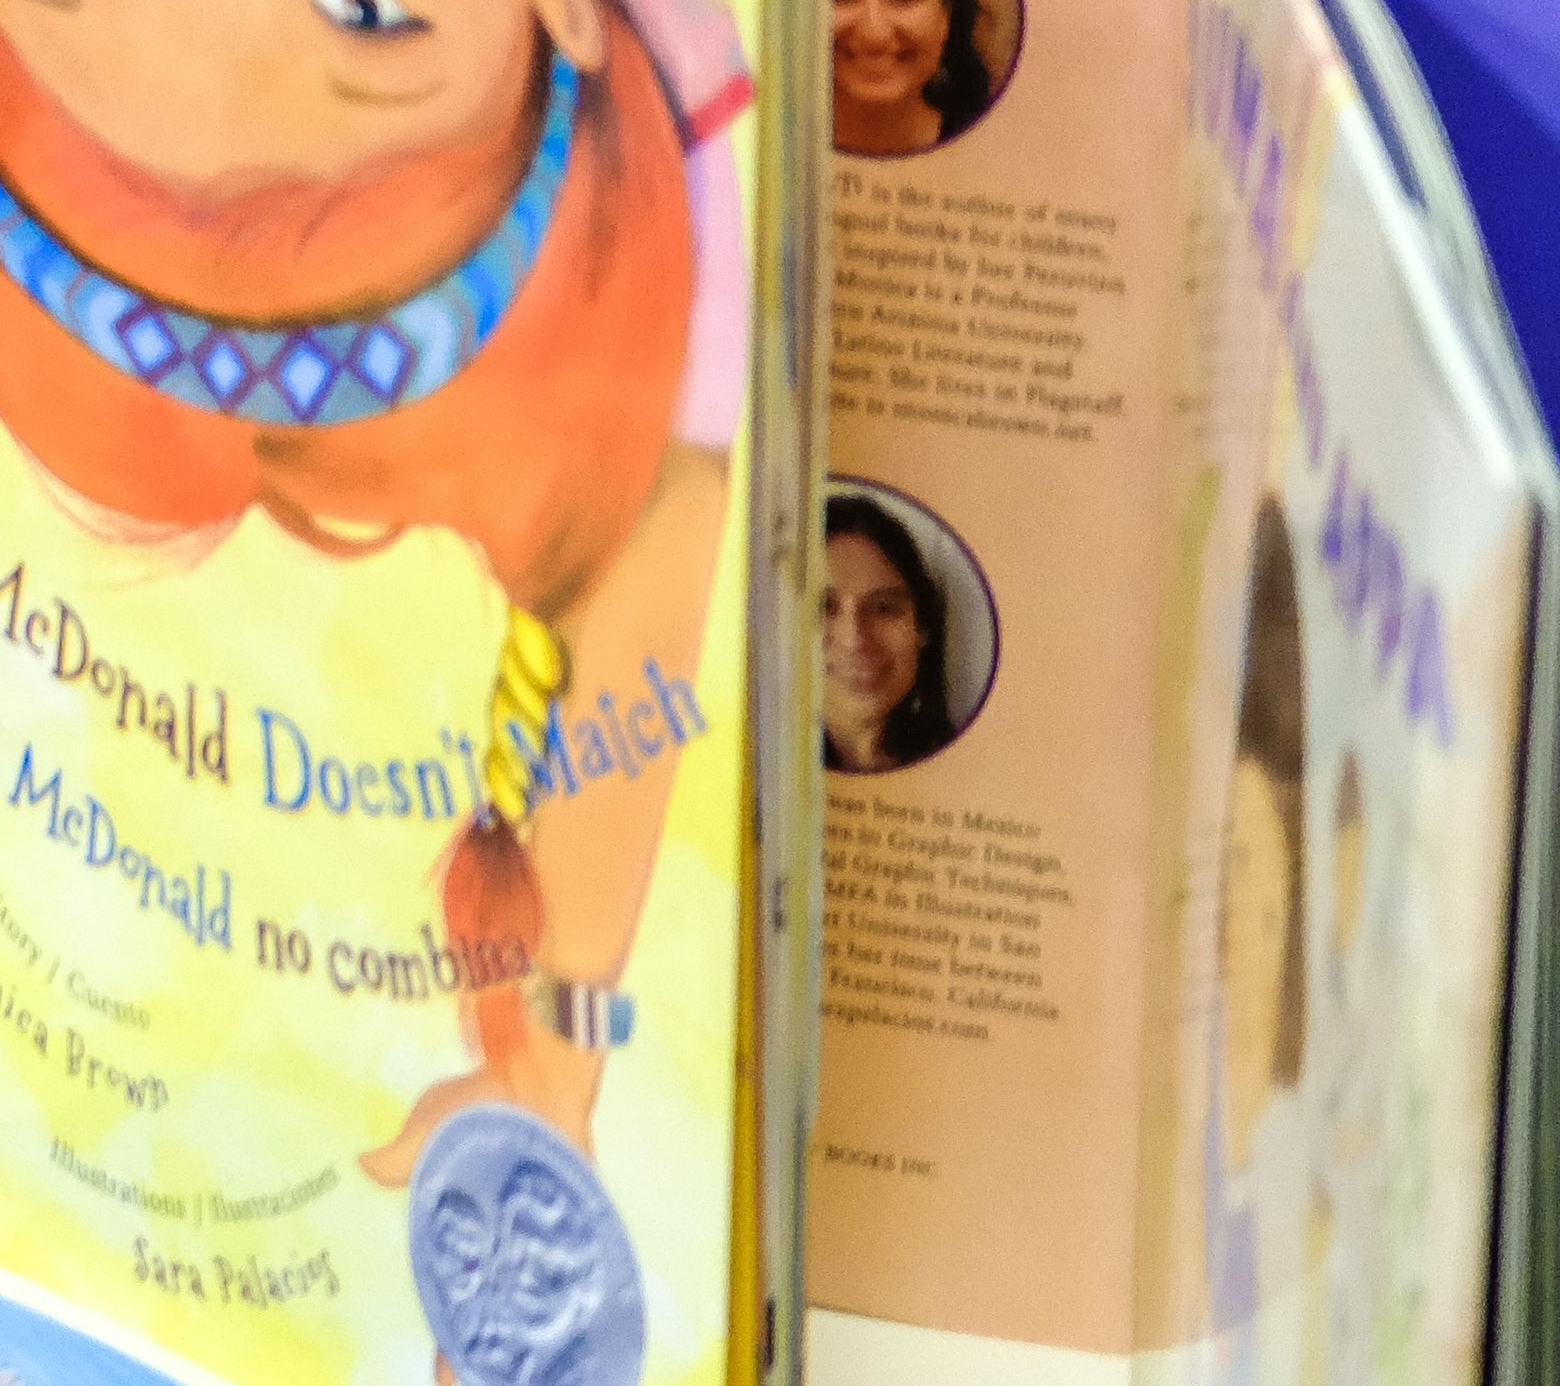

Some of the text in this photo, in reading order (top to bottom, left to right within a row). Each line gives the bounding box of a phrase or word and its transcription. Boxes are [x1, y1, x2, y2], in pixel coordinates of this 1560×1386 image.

[256, 707, 501, 831] Doesn't
[506, 656, 711, 821] Match
[9, 741, 234, 951] McDonald
[256, 918, 311, 974] no
[66, 1028, 170, 1112] Brown
[134, 1235, 342, 1309] Sara Palacios
